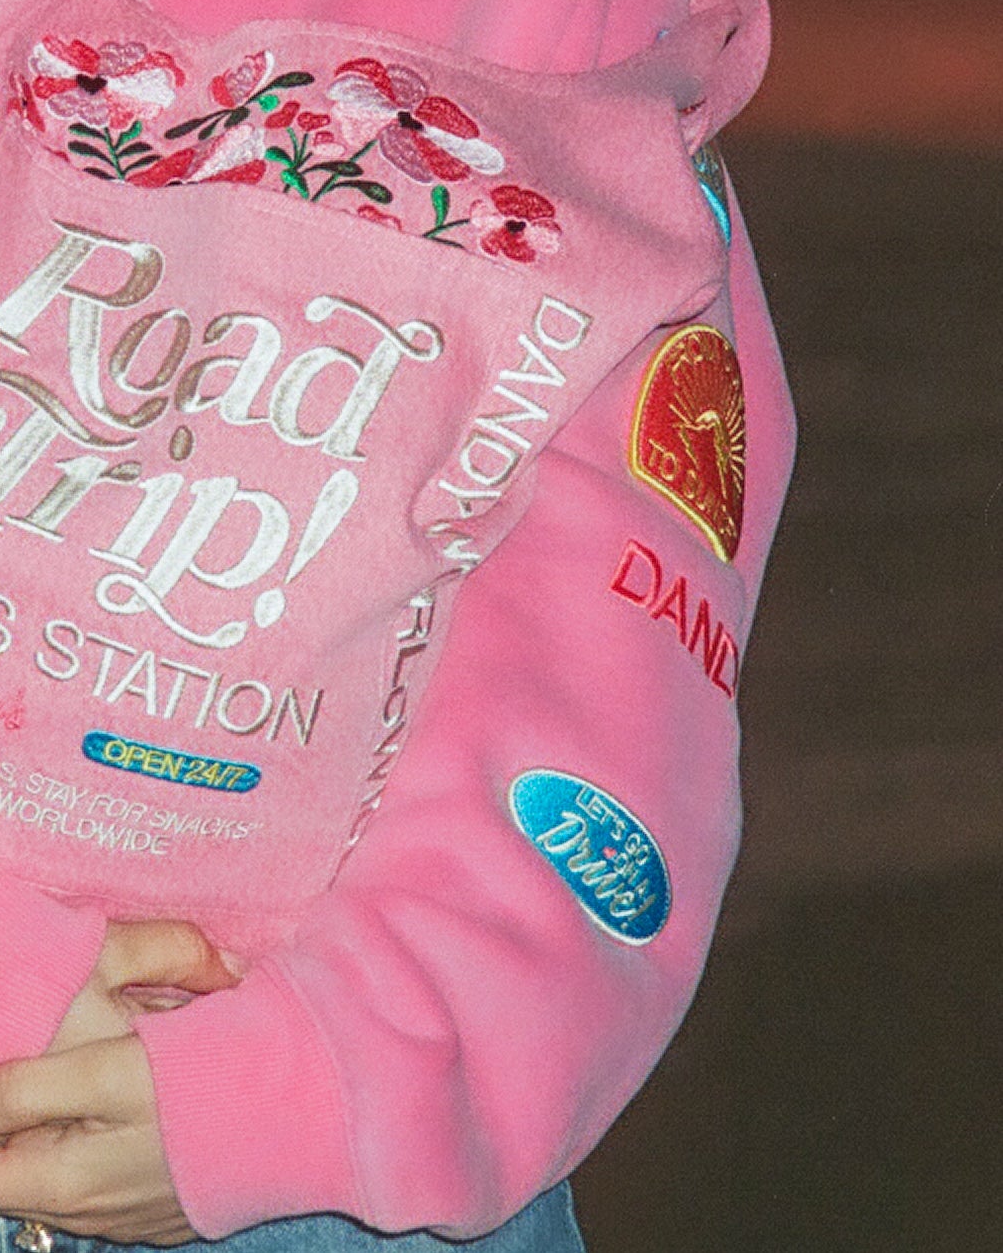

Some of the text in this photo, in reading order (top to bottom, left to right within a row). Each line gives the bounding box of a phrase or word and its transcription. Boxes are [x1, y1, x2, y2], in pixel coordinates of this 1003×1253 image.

[438, 294, 594, 519] DANDY
[609, 538, 739, 701] DAND
[34, 619, 325, 746] STATION
[25, 771, 89, 810] STAY
[88, 793, 149, 823] FOR
[103, 739, 249, 789] OPEN 24/7
[575, 786, 627, 841] LET'S
[535, 811, 657, 929] Drive!
